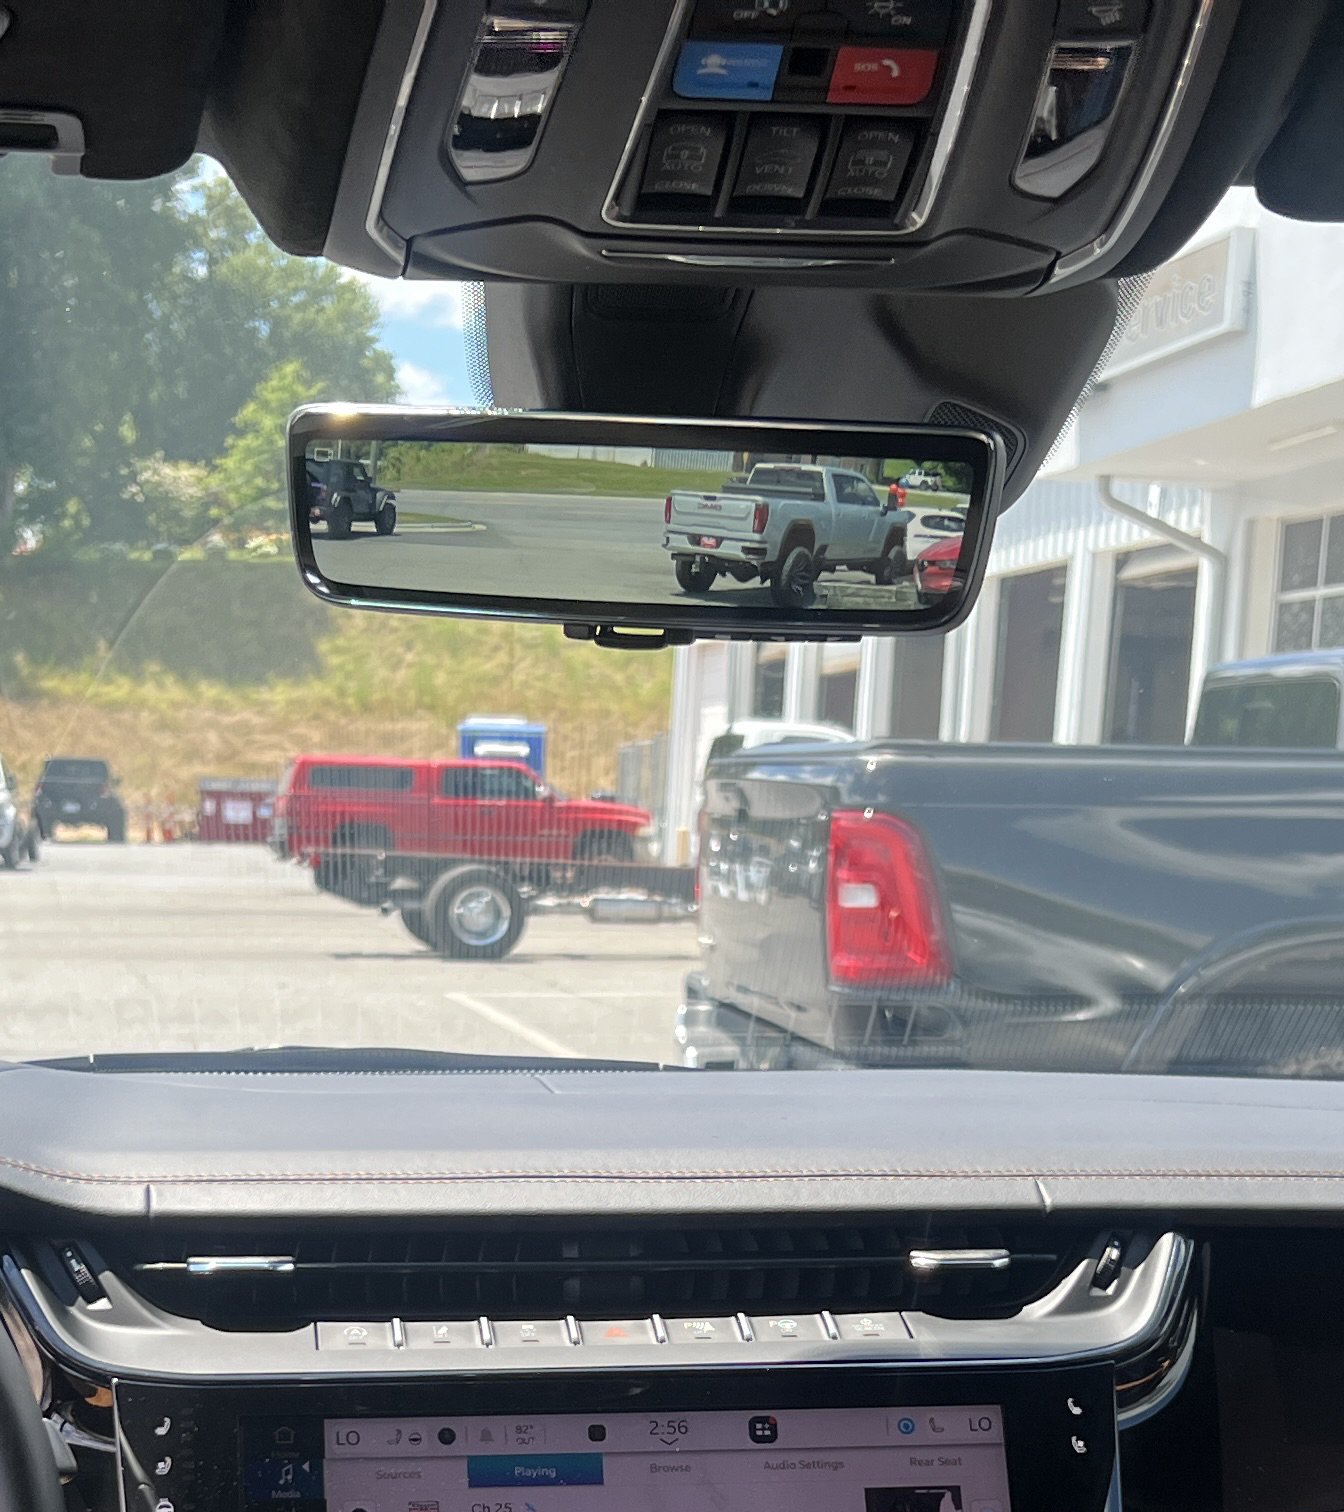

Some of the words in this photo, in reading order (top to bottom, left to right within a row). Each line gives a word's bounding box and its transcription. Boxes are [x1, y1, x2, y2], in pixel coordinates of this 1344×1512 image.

[891, 16, 912, 25] ON
[854, 63, 878, 72] SOS
[1125, 274, 1216, 343] ervice
[649, 1418, 688, 1436] 2:56
[968, 1416, 992, 1432] LO
[335, 1430, 361, 1446] LO
[763, 1459, 796, 1471] Audio
[798, 1458, 845, 1471] Settings
[909, 1456, 935, 1467] Rear
[938, 1456, 963, 1467] Seat
[375, 1468, 423, 1480] Sources
[514, 1466, 556, 1479] Playing
[649, 1462, 692, 1474] Browse
[271, 1490, 301, 1499] Media
